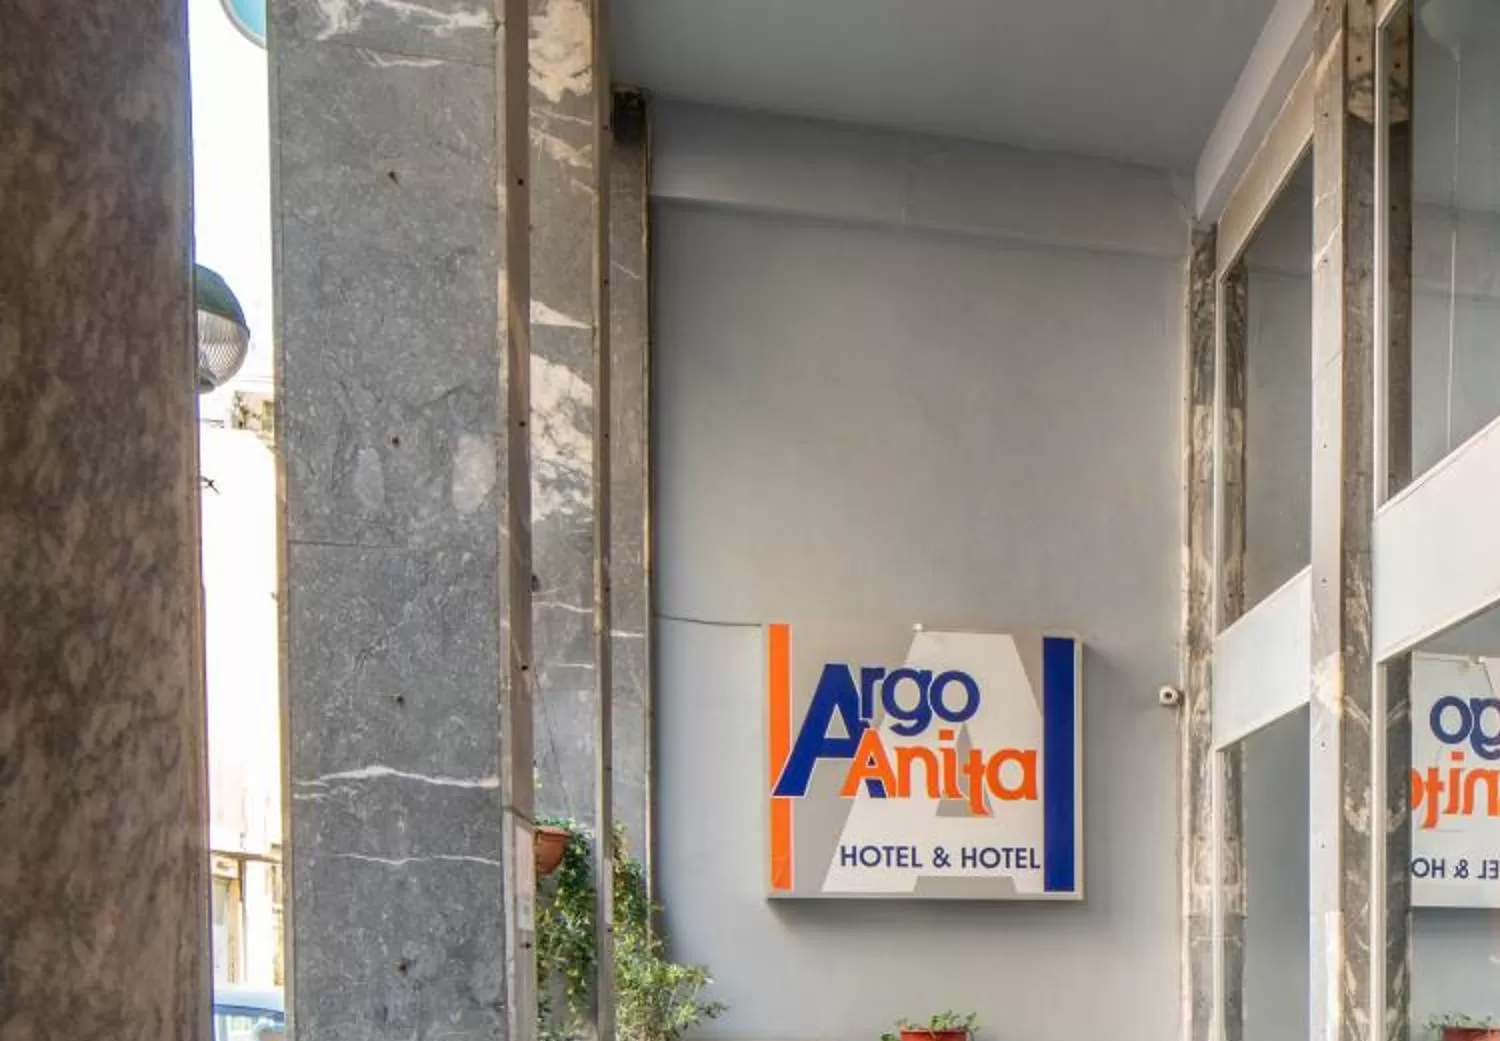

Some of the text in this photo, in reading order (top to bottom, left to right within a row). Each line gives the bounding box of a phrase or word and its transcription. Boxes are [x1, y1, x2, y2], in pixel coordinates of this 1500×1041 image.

[772, 663, 981, 797] Argo
[839, 728, 1038, 816] Anita
[840, 845, 1041, 869] HOTEL & HOTEL
